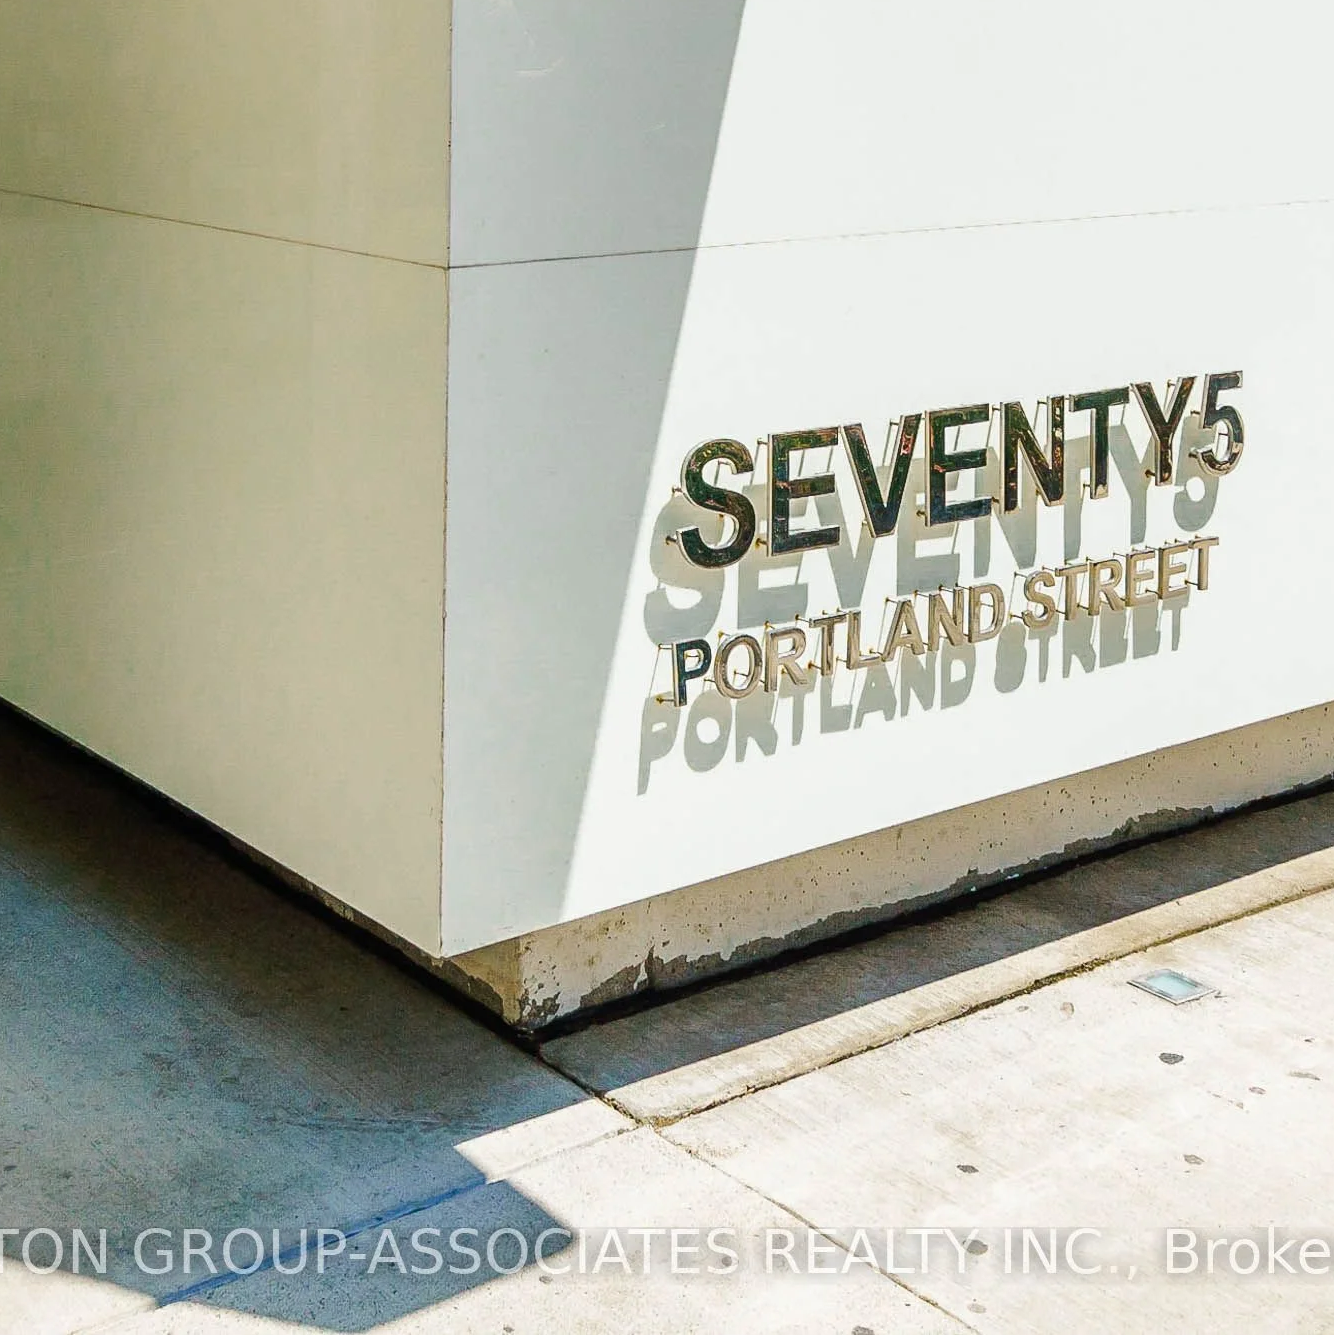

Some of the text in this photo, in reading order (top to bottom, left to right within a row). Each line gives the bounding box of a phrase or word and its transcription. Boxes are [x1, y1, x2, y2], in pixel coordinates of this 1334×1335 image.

[675, 369, 1245, 570] SEVENTY5
[670, 535, 1220, 708] PORTLAND STREET
